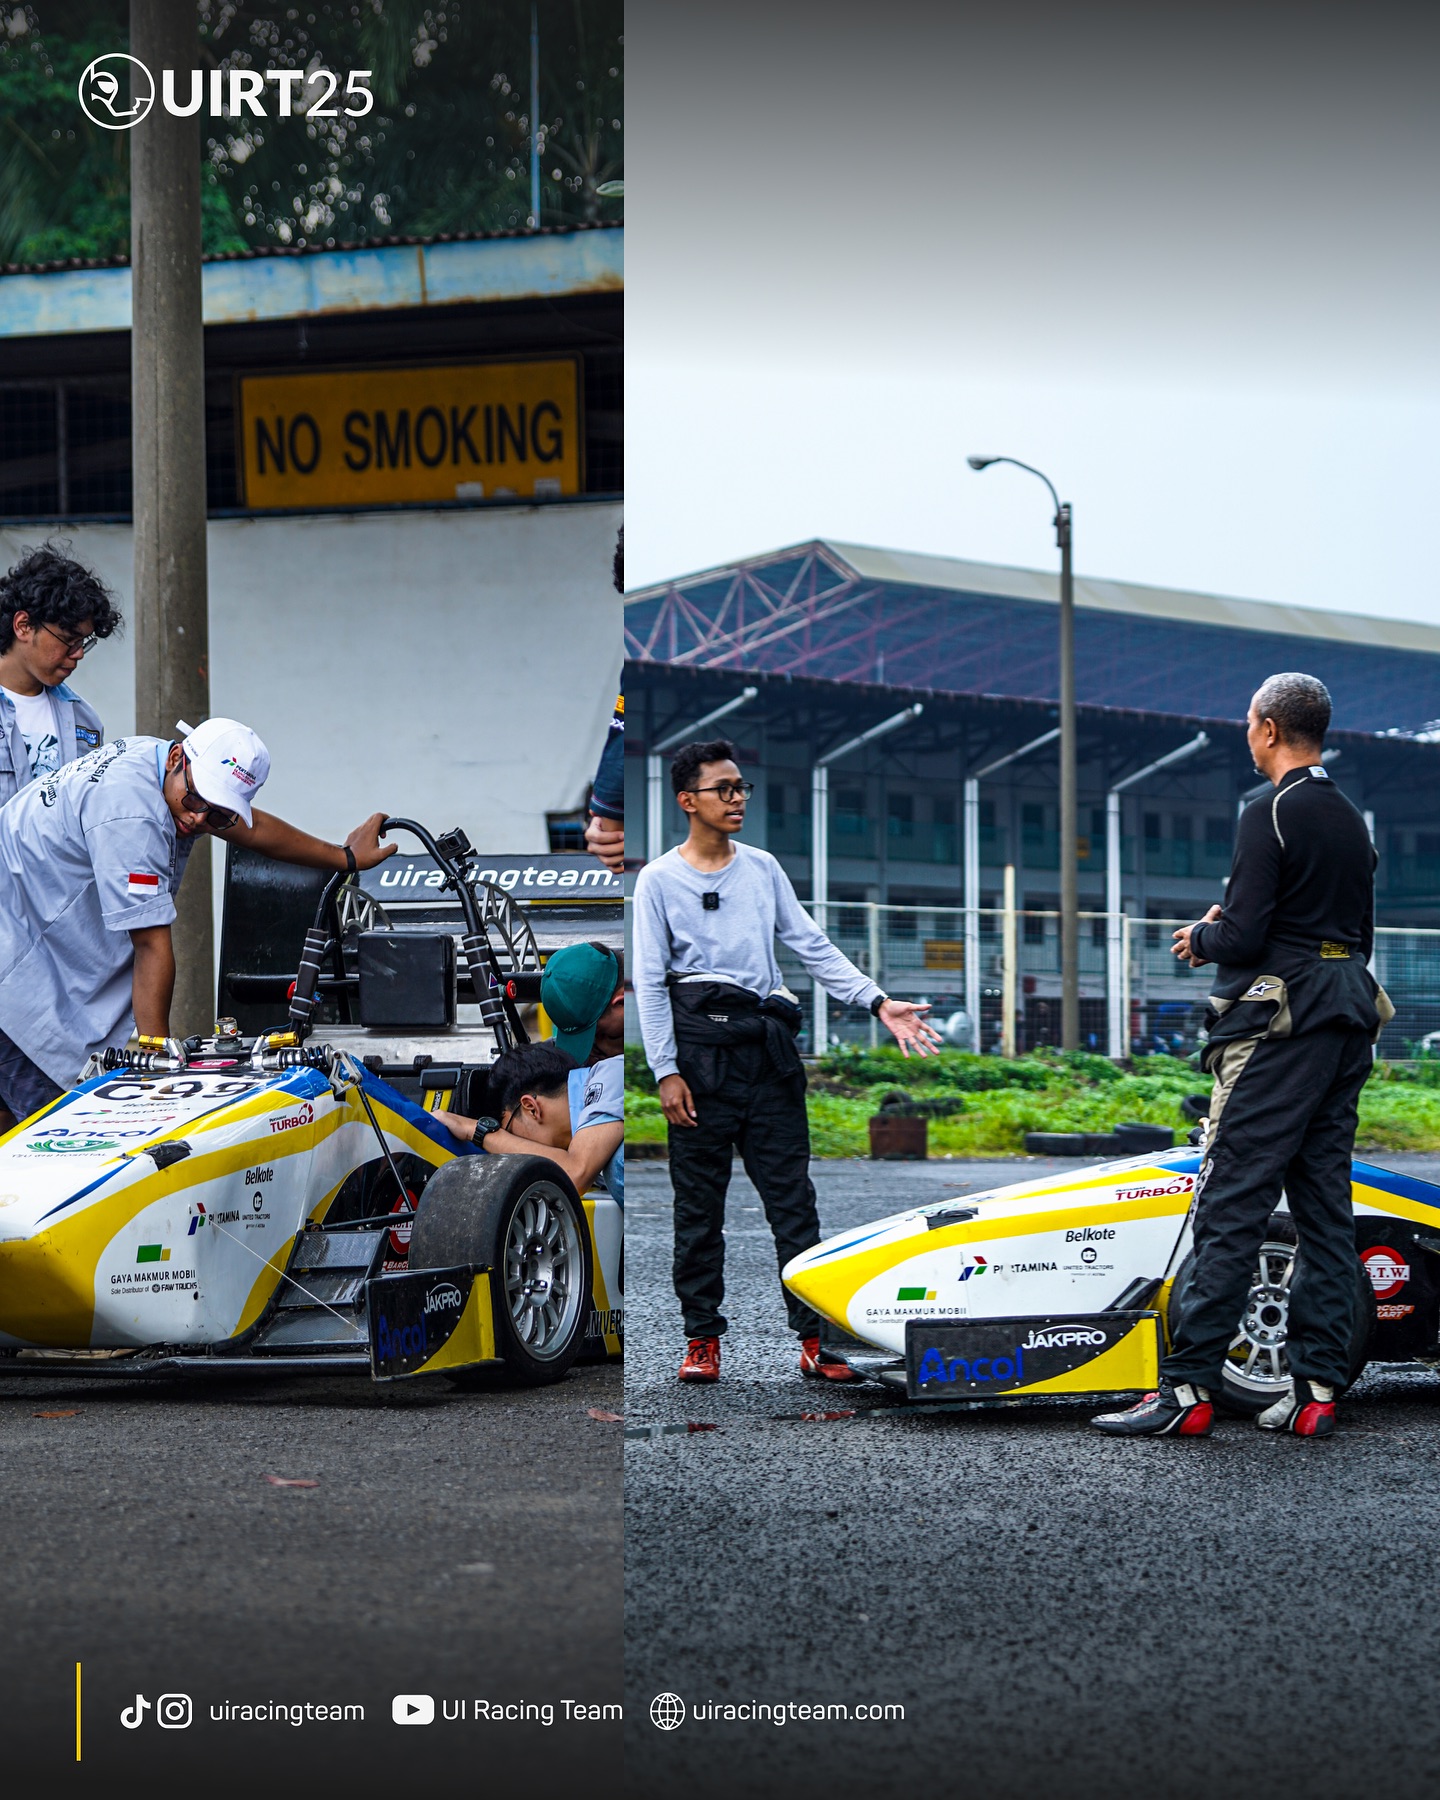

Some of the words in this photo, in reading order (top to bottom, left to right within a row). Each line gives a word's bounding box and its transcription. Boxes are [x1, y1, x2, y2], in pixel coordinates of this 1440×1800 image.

[255, 413, 321, 475] NO
[344, 400, 563, 471] SMOKING
[380, 864, 620, 890] uiraingteam.
[32, 1126, 164, 1138] Ancol
[270, 1114, 308, 1133] TURBO
[245, 1167, 274, 1186] Belkote
[1115, 1186, 1181, 1201] TURBO
[1065, 1228, 1116, 1243] Belkote
[111, 1274, 132, 1284] GAYA
[134, 1271, 170, 1283] MAKMUR
[161, 1283, 175, 1292] FAW
[866, 1308, 891, 1316] GAYA
[894, 1307, 936, 1316] MAKMUR
[378, 1311, 427, 1360] Ancol
[1021, 1329, 1107, 1349] JAKPRO
[917, 1347, 1024, 1383] Ancol
